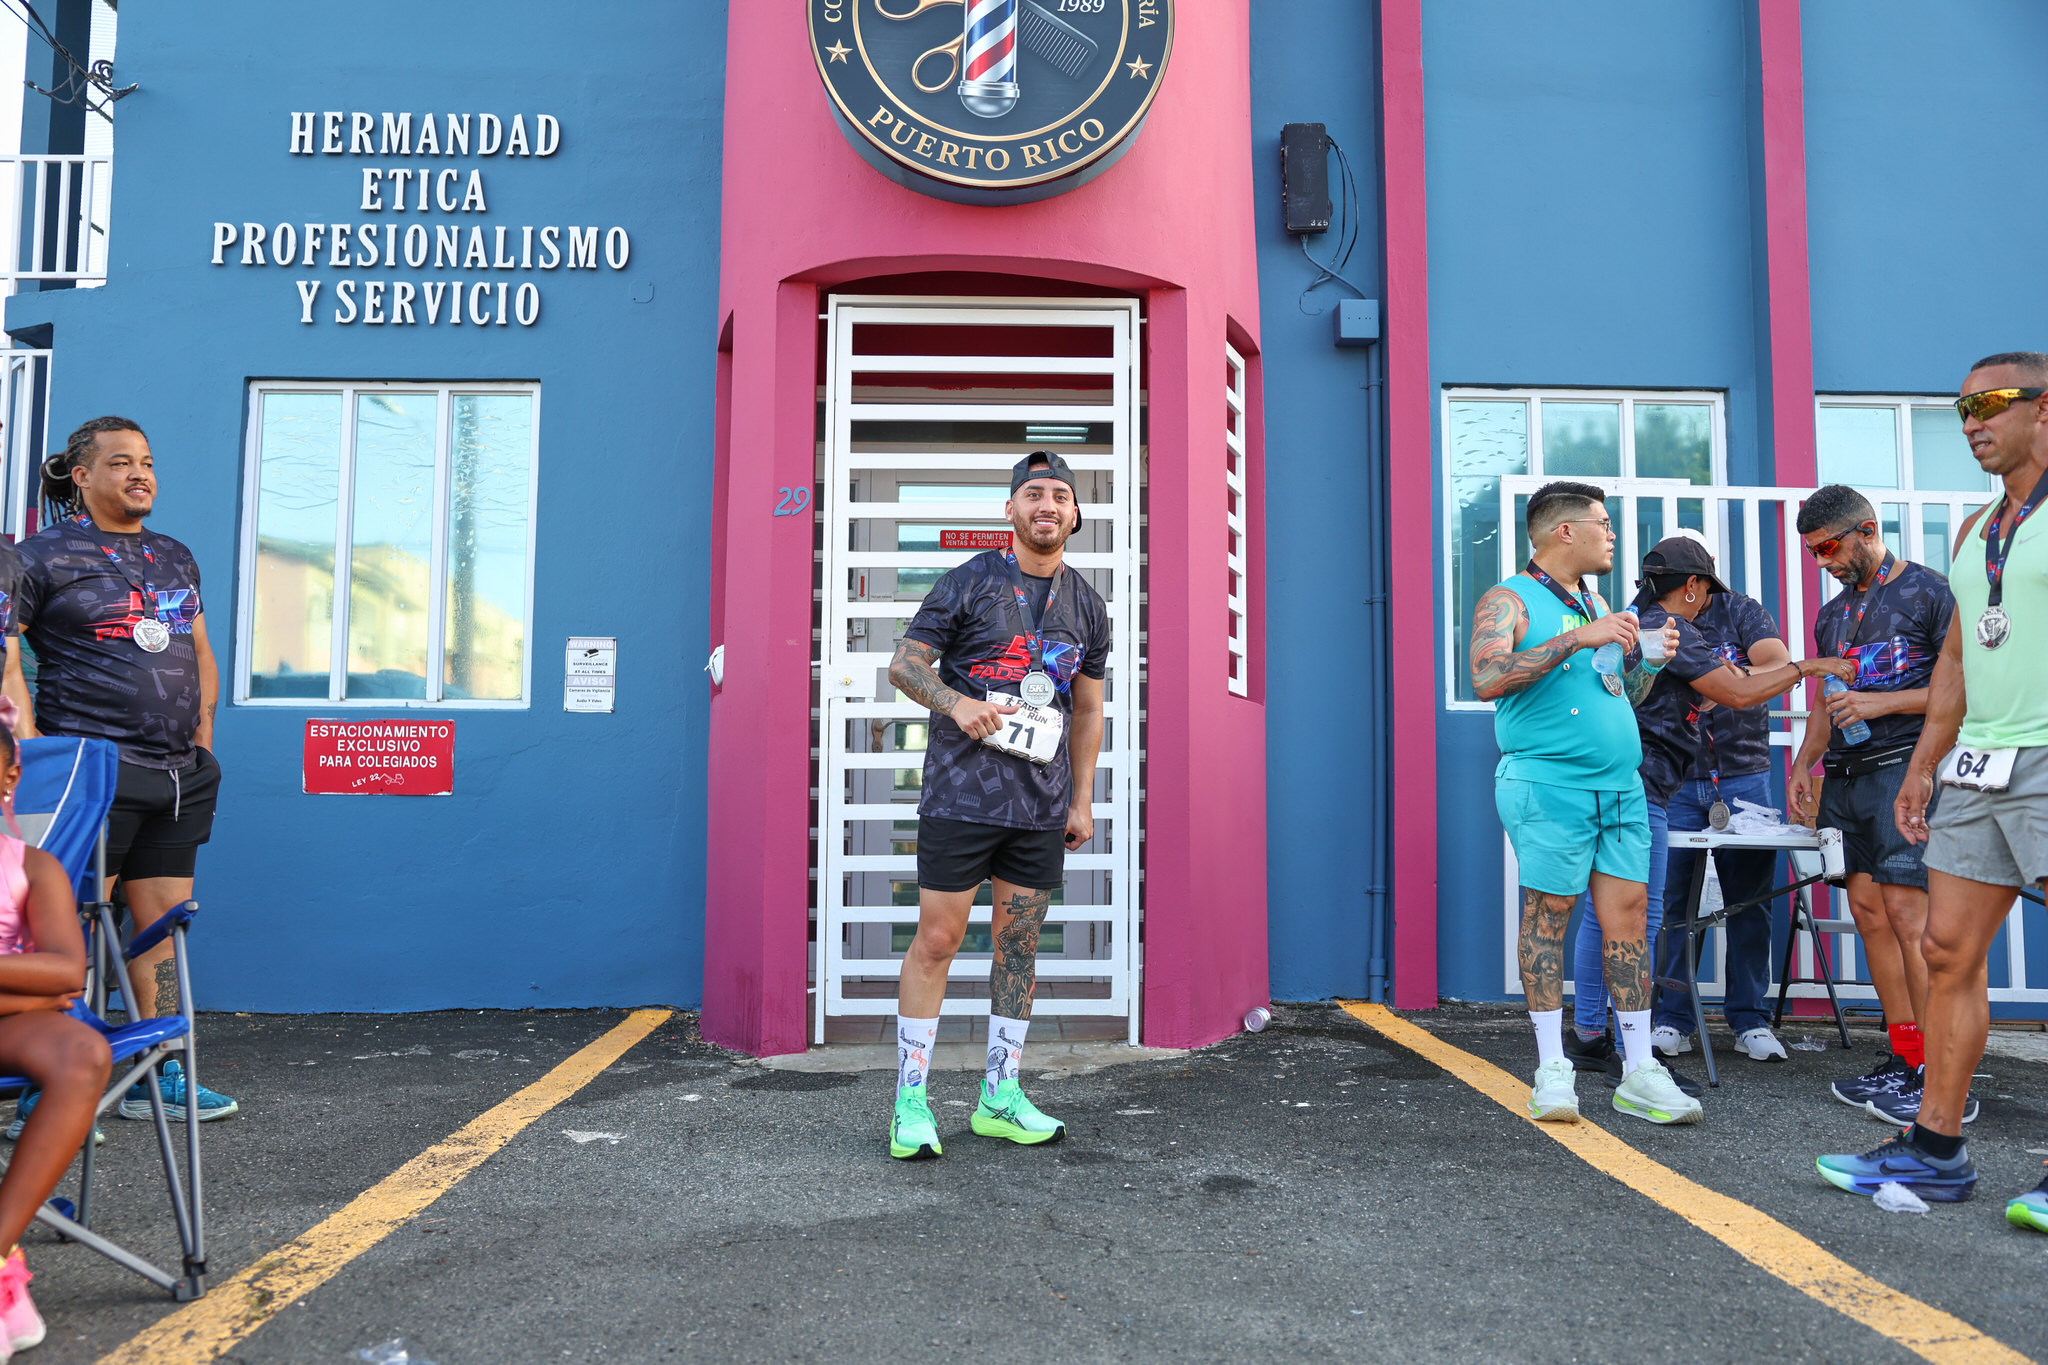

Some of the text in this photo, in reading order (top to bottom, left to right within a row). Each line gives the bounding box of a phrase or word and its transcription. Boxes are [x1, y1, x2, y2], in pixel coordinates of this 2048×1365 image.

[289, 111, 560, 156] HERMANDAD
[866, 105, 1105, 171] PUERTO RICO
[360, 168, 486, 212] ETICA
[211, 222, 630, 270] PROFESIONALISMO
[296, 280, 540, 326] Y SERVICIO
[773, 486, 811, 516] 29
[945, 532, 1009, 540] NO SE PERMITEN
[570, 641, 612, 649] WARNING
[968, 664, 1028, 681] FADE
[573, 677, 607, 686] AVISO
[1027, 711, 1049, 725] RUN
[310, 725, 449, 738] ESTACIONAMIENTO
[1008, 720, 1036, 750] 71
[337, 739, 421, 752] EXCLUSIVO
[319, 755, 438, 768] PARA COLEGIADOS
[1956, 751, 1991, 778] 64
[351, 772, 379, 787] LEY 22
